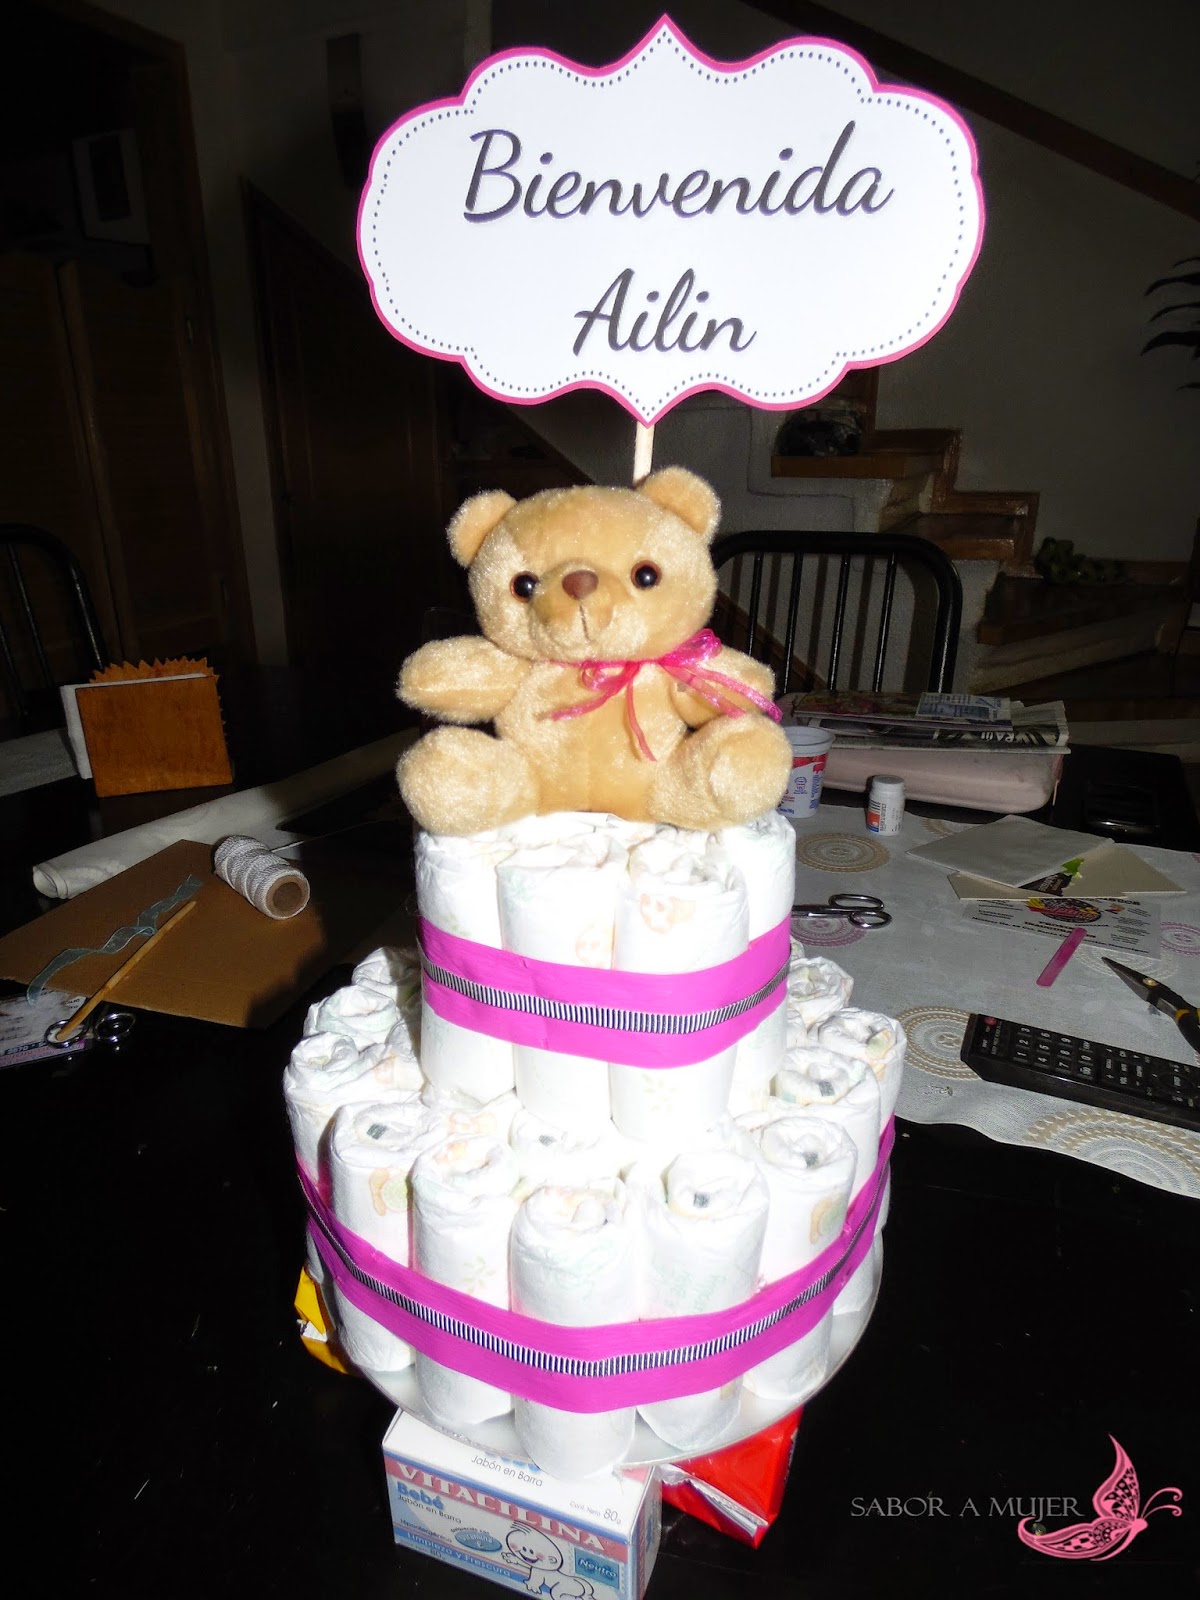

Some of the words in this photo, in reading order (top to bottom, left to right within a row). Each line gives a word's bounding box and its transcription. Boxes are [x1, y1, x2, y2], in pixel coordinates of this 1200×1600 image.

[463, 121, 894, 223] Bienvenida
[573, 268, 757, 356] Ailin
[470, 1455, 502, 1471] Jabón
[503, 1466, 516, 1477] en
[517, 1469, 543, 1487] Barra
[397, 1481, 444, 1511] Bebé
[397, 1461, 605, 1551] VITACILINA
[398, 1494, 424, 1510] Jabón
[425, 1506, 438, 1516] en
[438, 1511, 462, 1524] Barra
[406, 1532, 453, 1556] Limpieza
[465, 1554, 512, 1578] Frescura
[578, 1558, 618, 1578] Neutro
